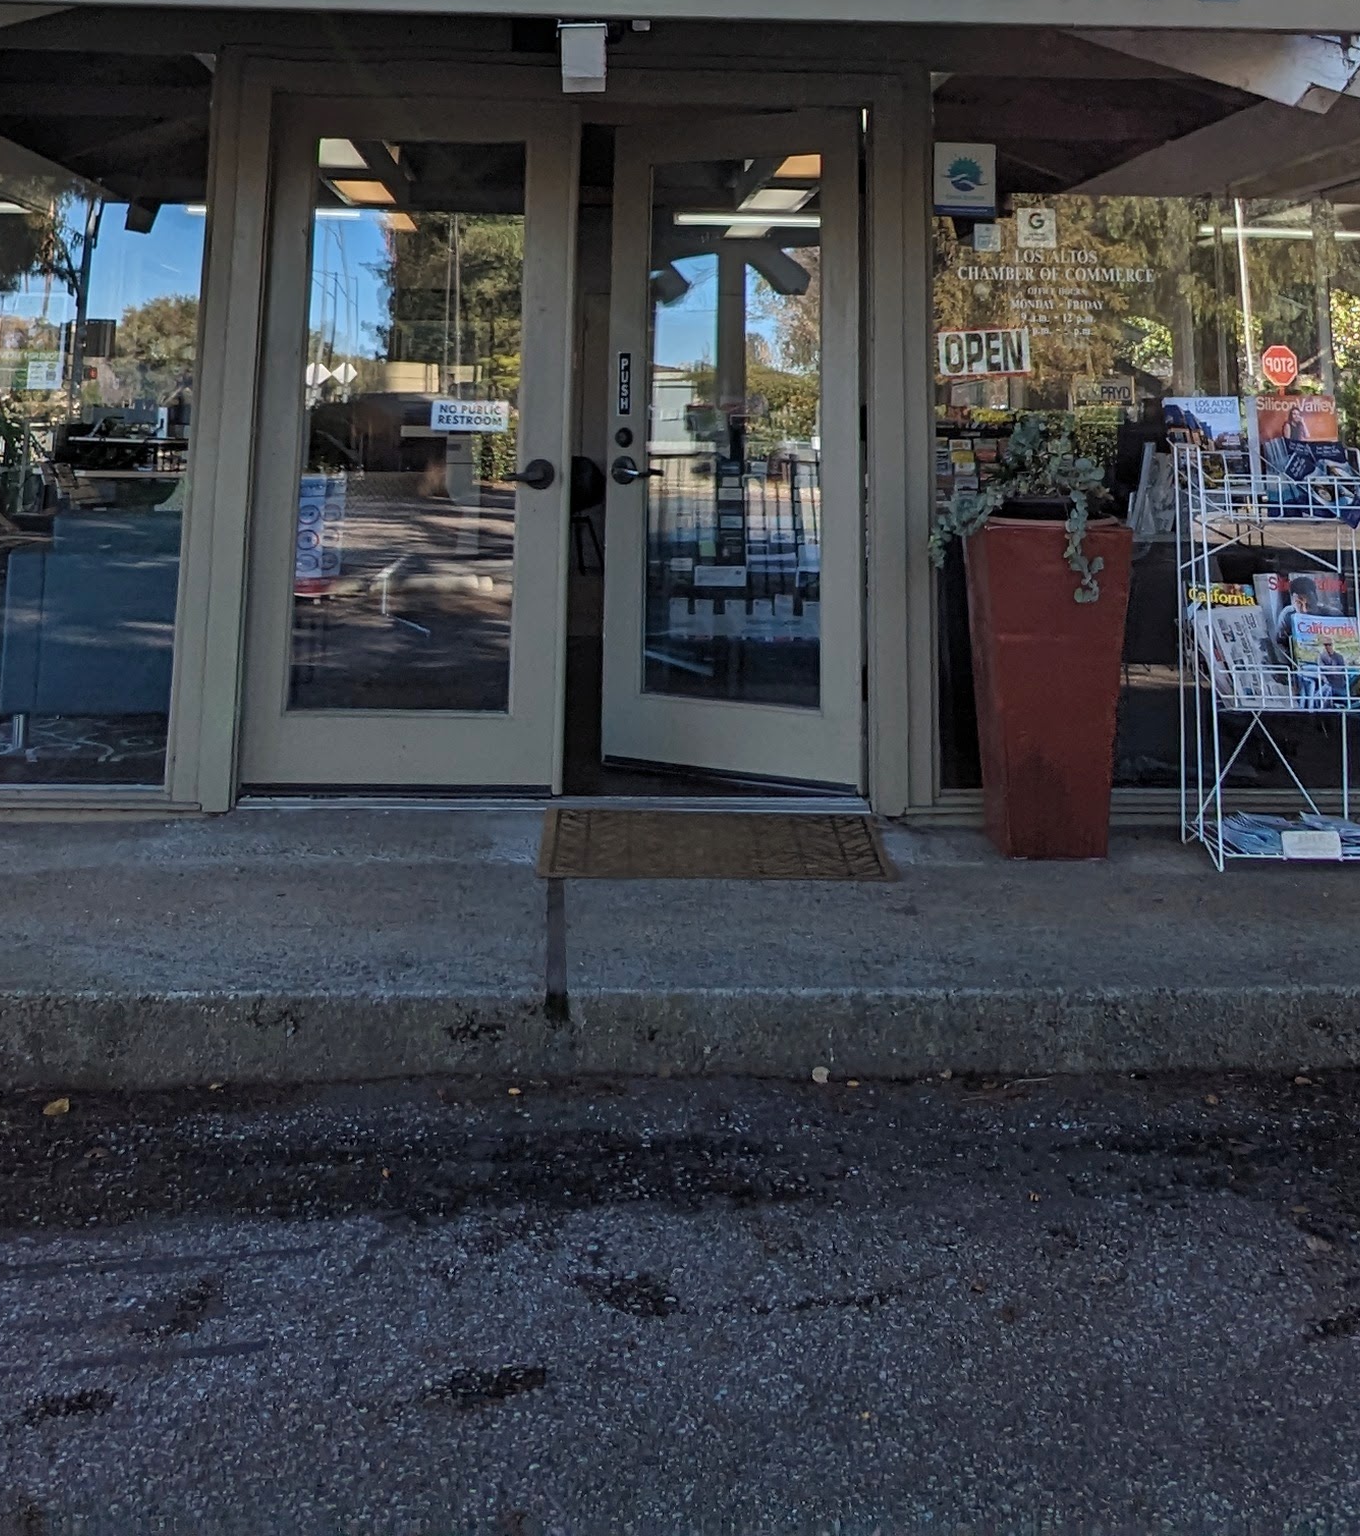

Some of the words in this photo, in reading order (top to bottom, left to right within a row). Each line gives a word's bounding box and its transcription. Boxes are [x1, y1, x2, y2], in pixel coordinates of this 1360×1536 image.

[1015, 250, 1043, 264] LOS
[1052, 250, 1098, 264] ALTOS
[958, 266, 1034, 281] CHAMBER
[1040, 267, 1060, 281] OF
[1065, 268, 1155, 283] COMMERCE
[1011, 300, 1054, 310] MONDAY
[1066, 300, 1104, 311] FRIDAY
[944, 331, 1024, 374] OPEN
[620, 358, 629, 410] PUSH
[440, 405, 457, 414] NO
[462, 405, 502, 415] PUBLIC
[1195, 399, 1210, 407] LOS
[1211, 399, 1236, 407] ALTOS
[1195, 407, 1236, 415] MAGAZINE
[437, 415, 503, 426] RESTROOM
[1188, 587, 1257, 606] Caifornia
[1297, 621, 1356, 637] California
